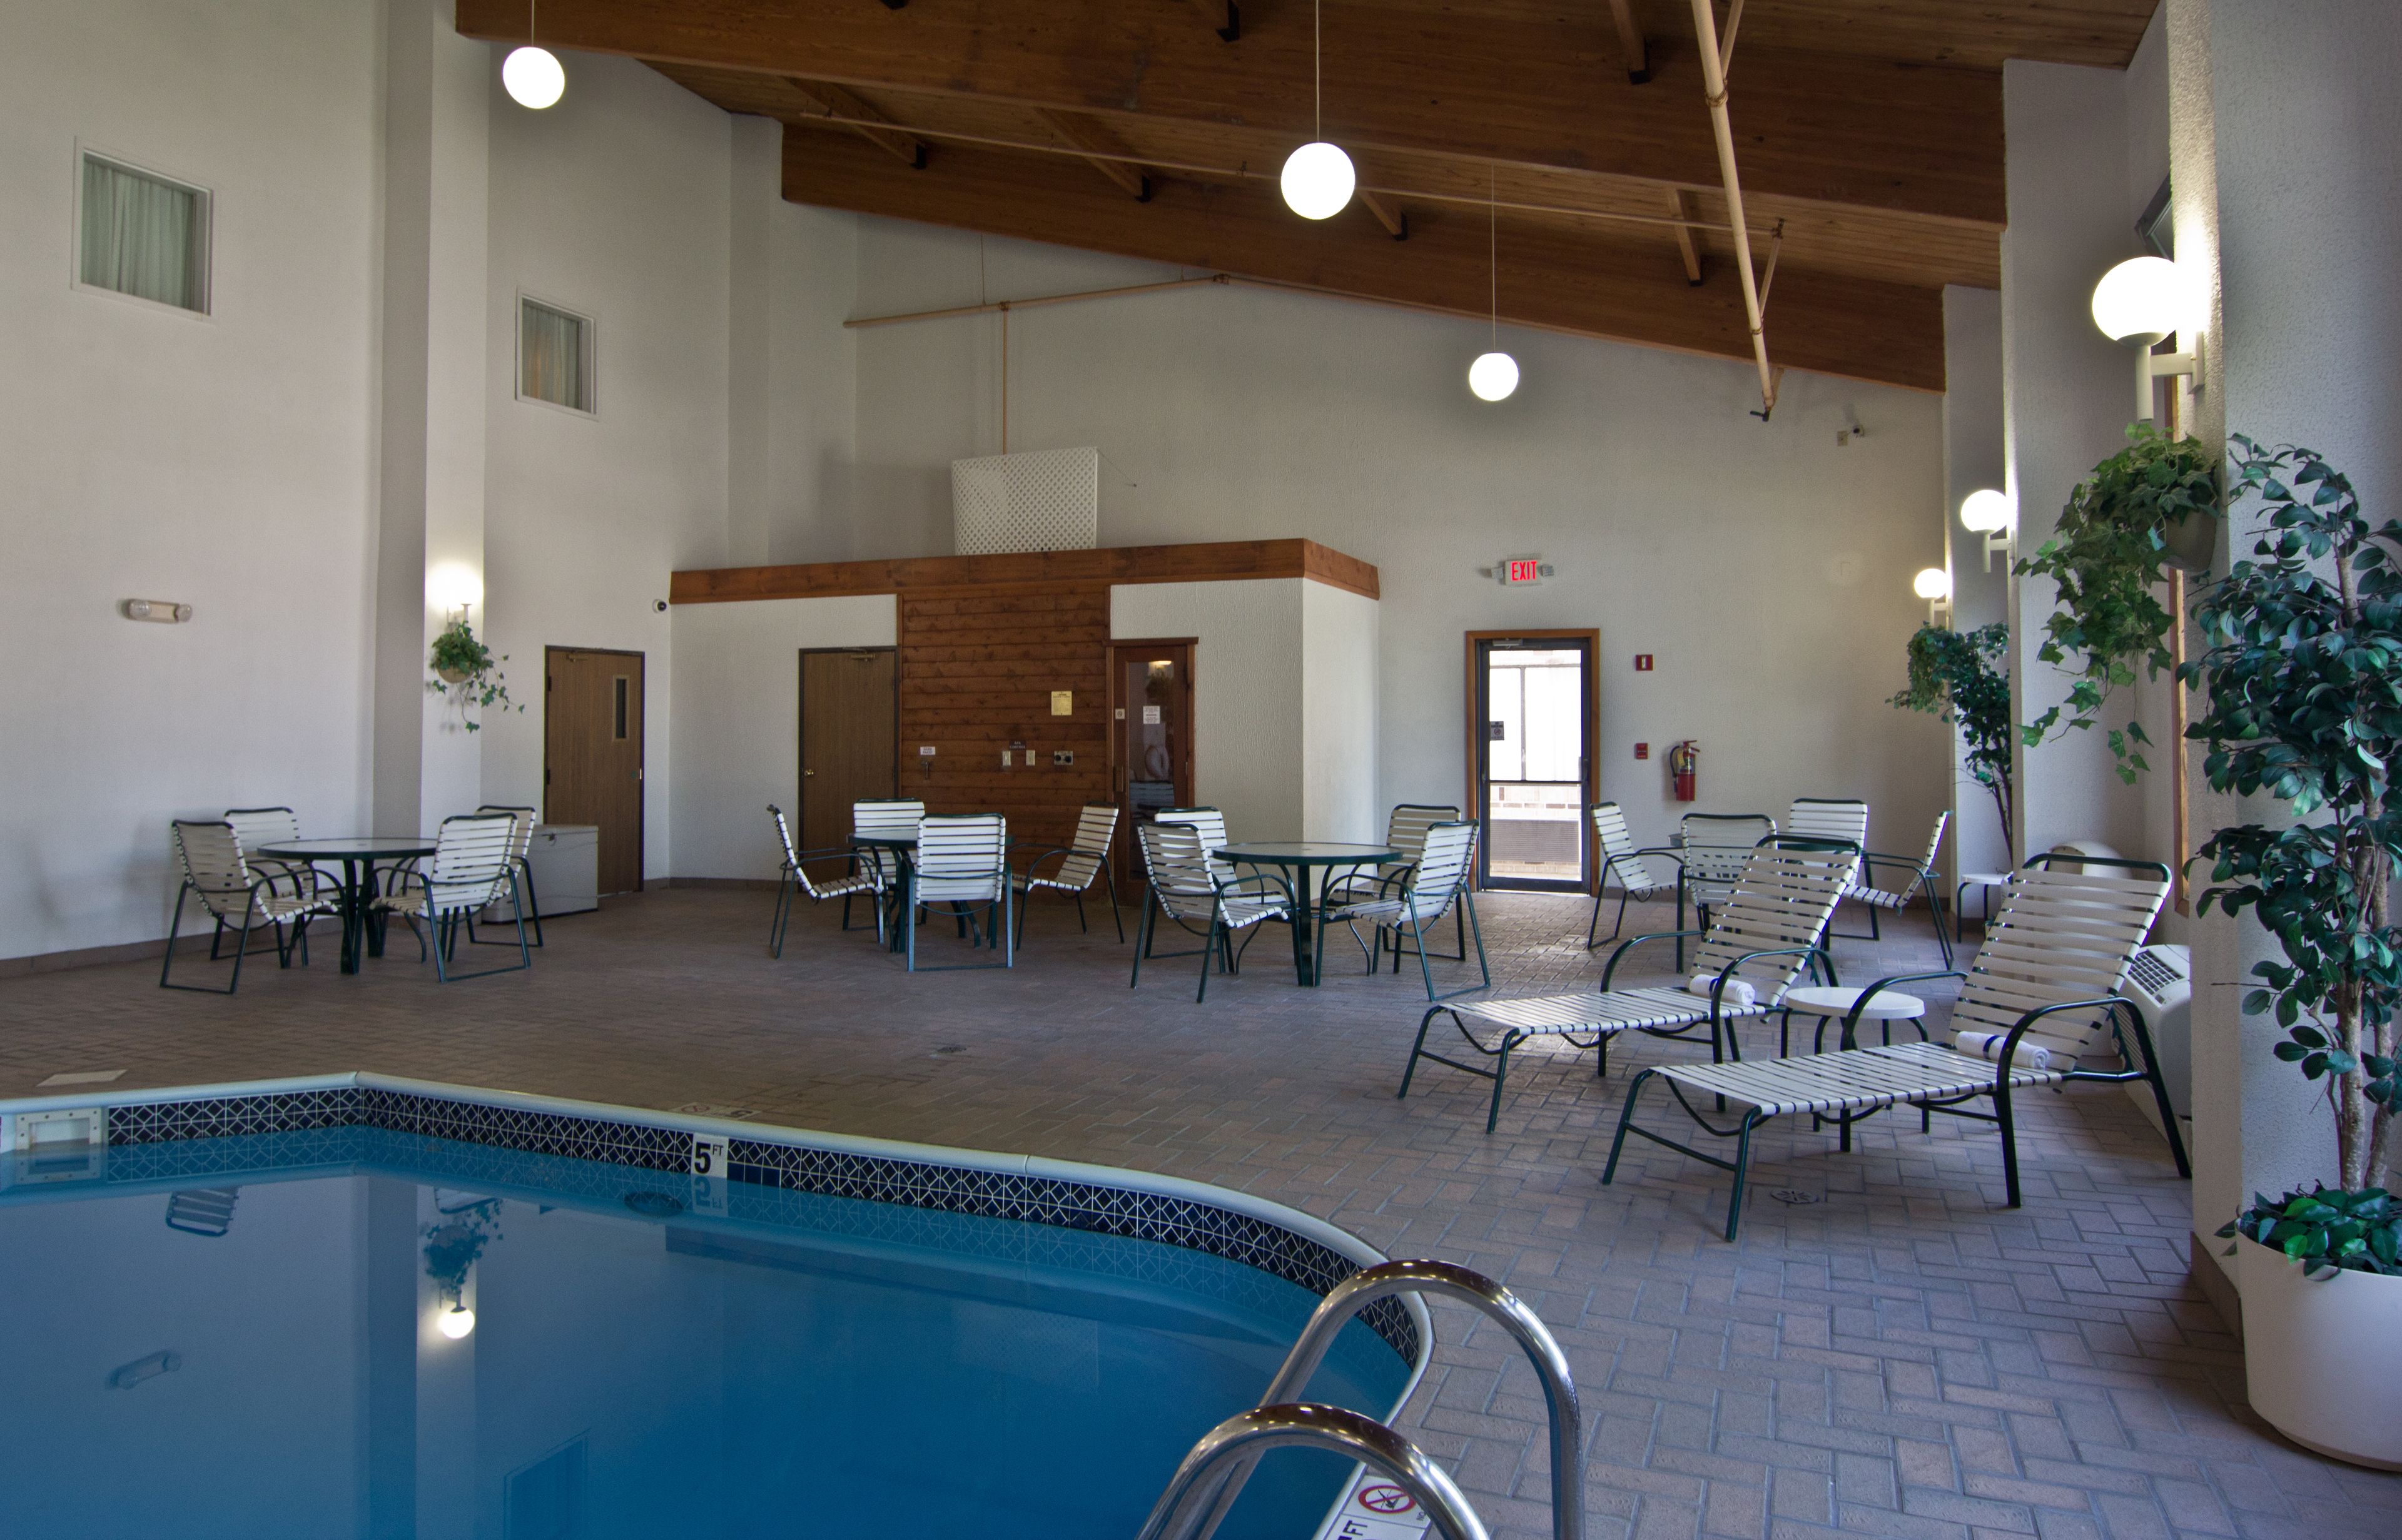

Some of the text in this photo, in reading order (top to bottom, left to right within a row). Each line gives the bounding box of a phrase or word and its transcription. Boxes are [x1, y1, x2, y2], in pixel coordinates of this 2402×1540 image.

[1511, 560, 1537, 580] EXIT
[694, 1142, 724, 1174] 5 FT
[1342, 1519, 1368, 1536] FT
